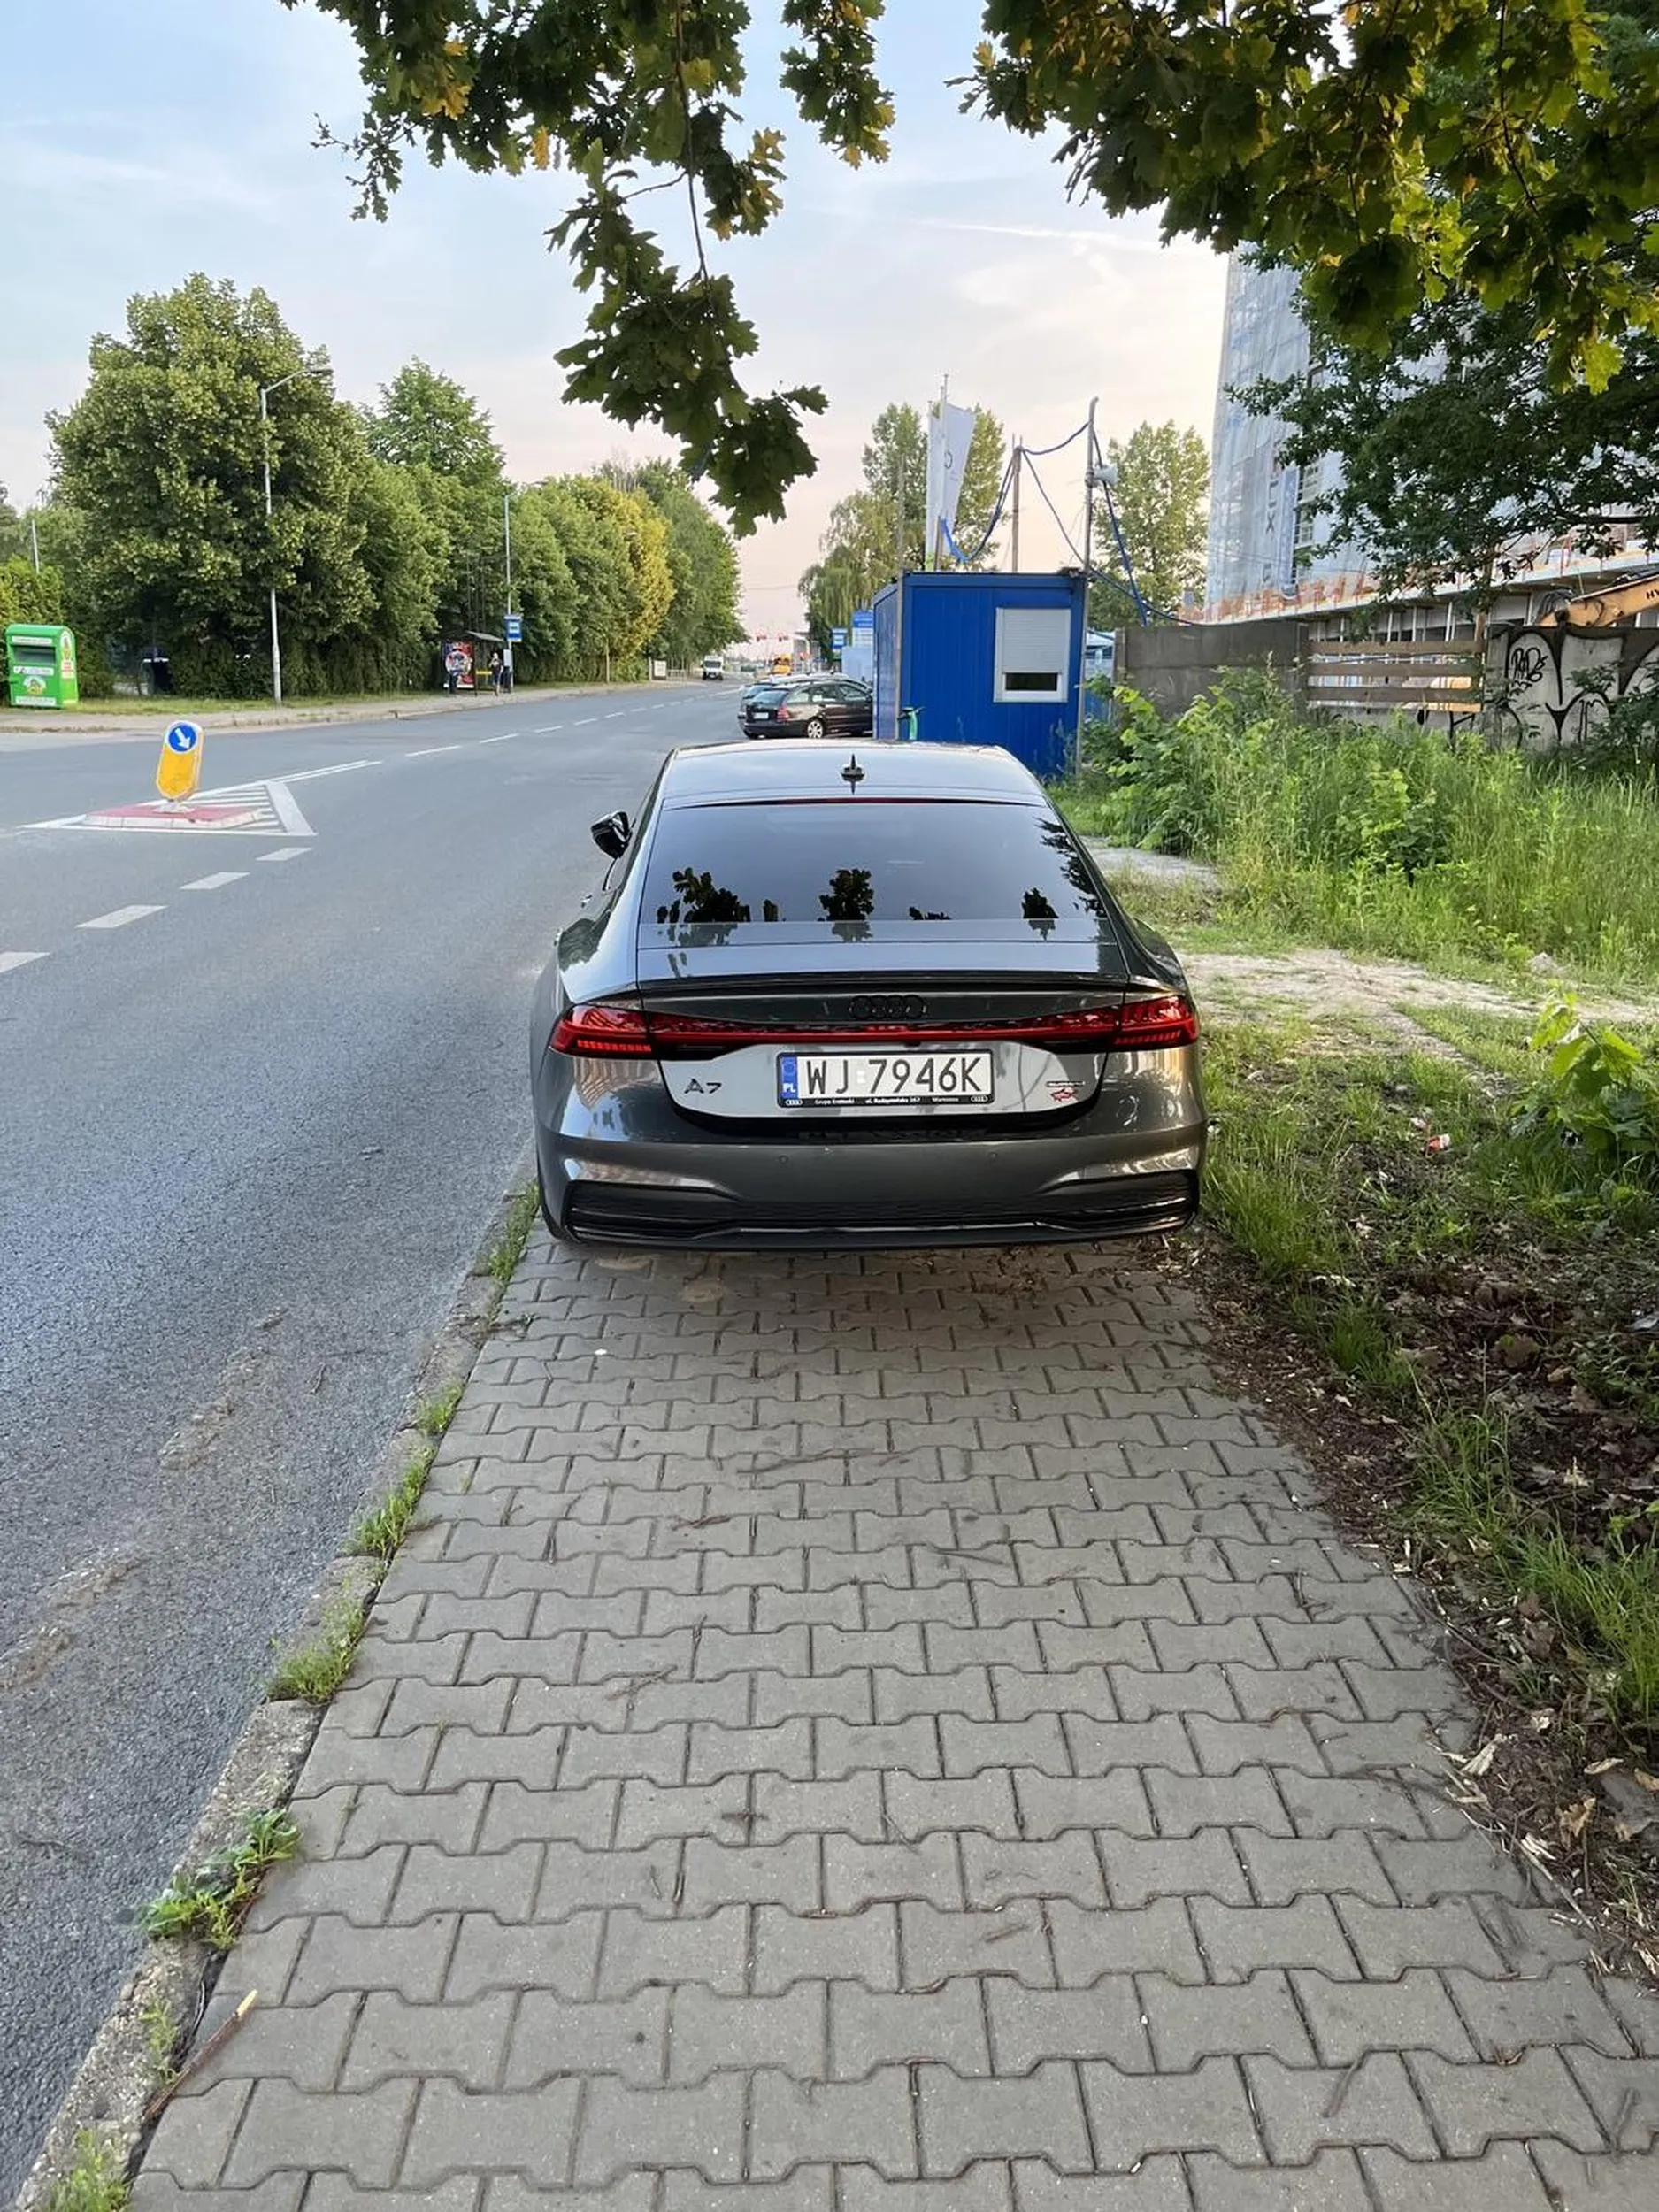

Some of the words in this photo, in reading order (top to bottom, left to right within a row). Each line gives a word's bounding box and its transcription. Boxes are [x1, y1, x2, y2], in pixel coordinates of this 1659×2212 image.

[806, 1059, 849, 1095] WJ
[868, 1056, 982, 1094] 7946K
[684, 1078, 722, 1094] A7
[783, 1082, 796, 1093] PL
